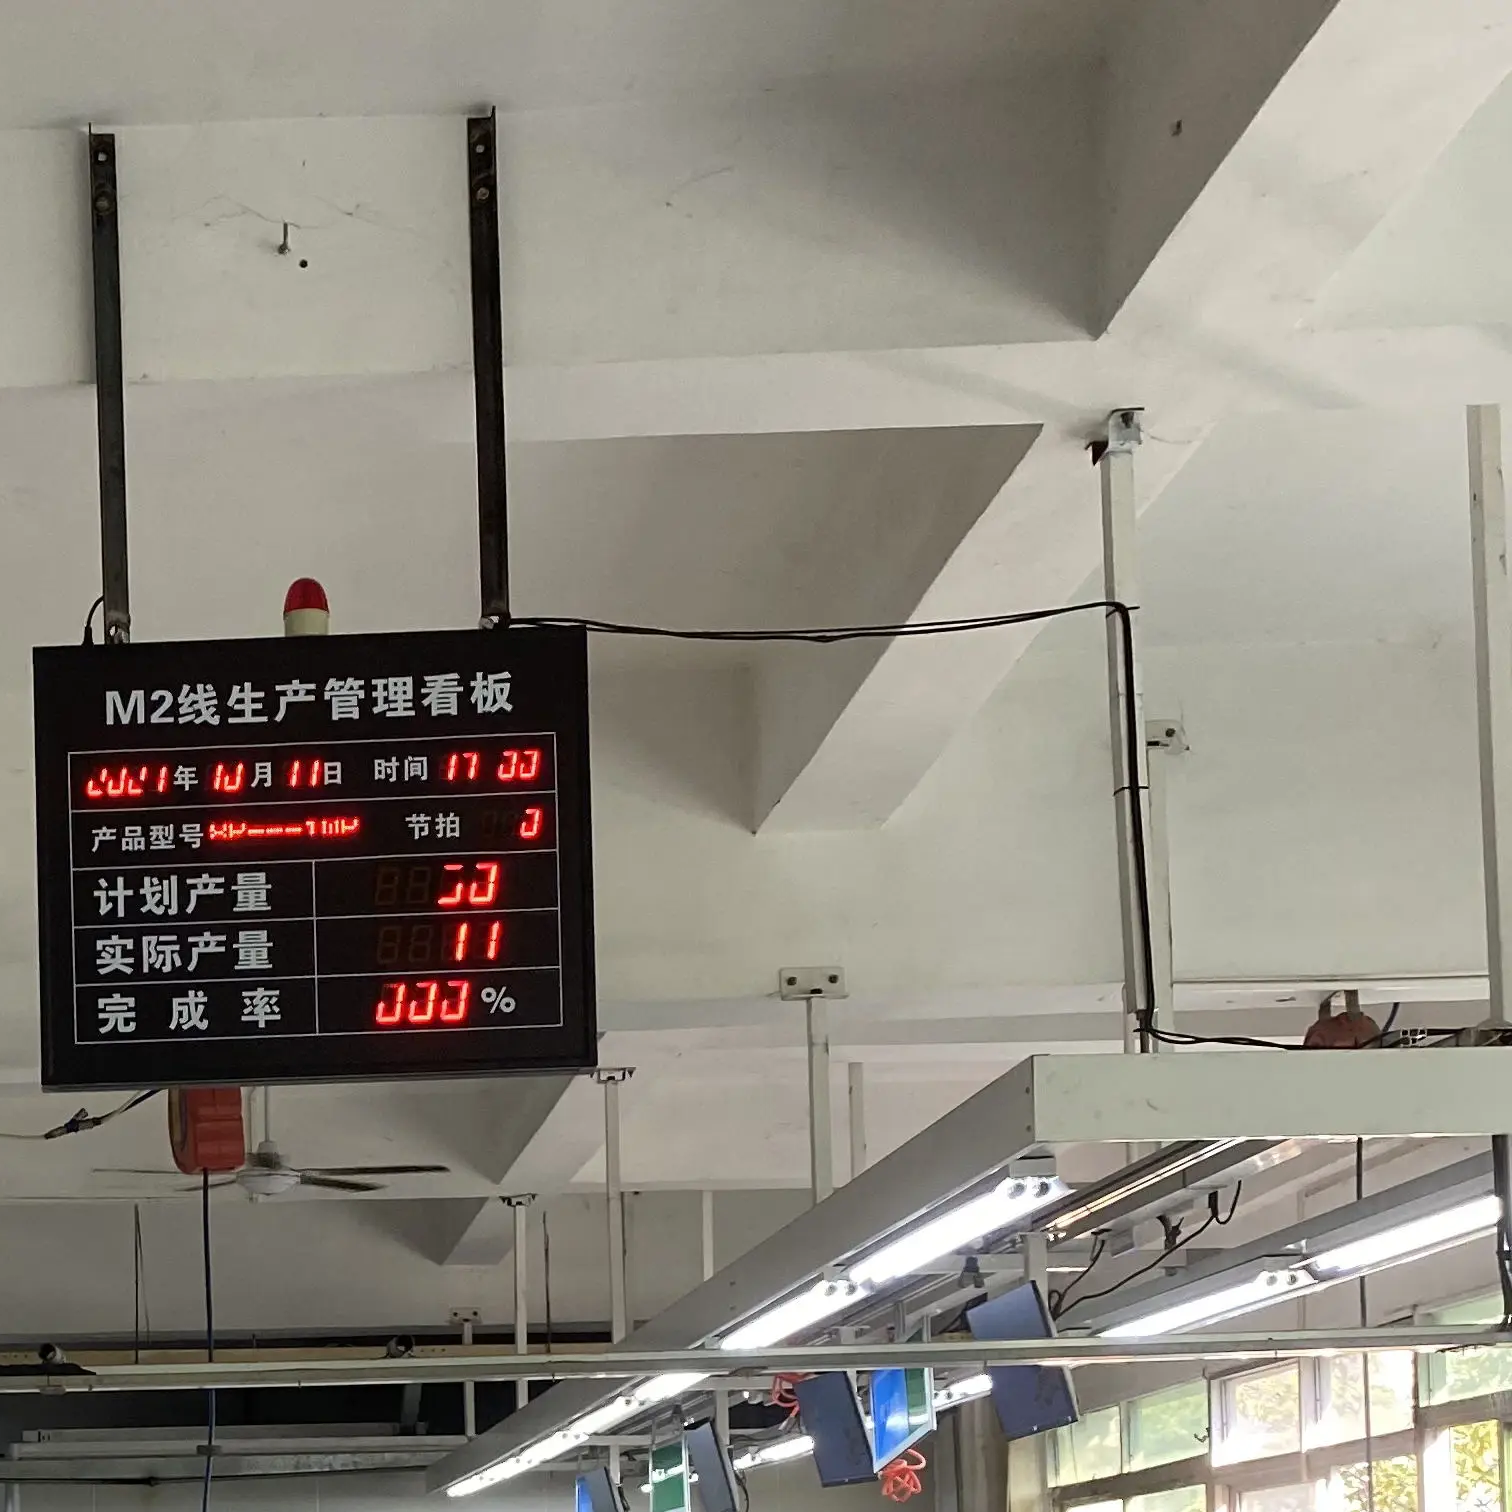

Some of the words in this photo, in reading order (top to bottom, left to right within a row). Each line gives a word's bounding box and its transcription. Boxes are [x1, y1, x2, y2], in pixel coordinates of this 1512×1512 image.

[104, 670, 514, 726] M2线生产管理看板
[374, 756, 428, 783] 时间
[91, 823, 204, 852] 产品型号
[405, 812, 461, 840] 节拍
[93, 871, 273, 918] 计划产量
[95, 929, 274, 975] 实际产量
